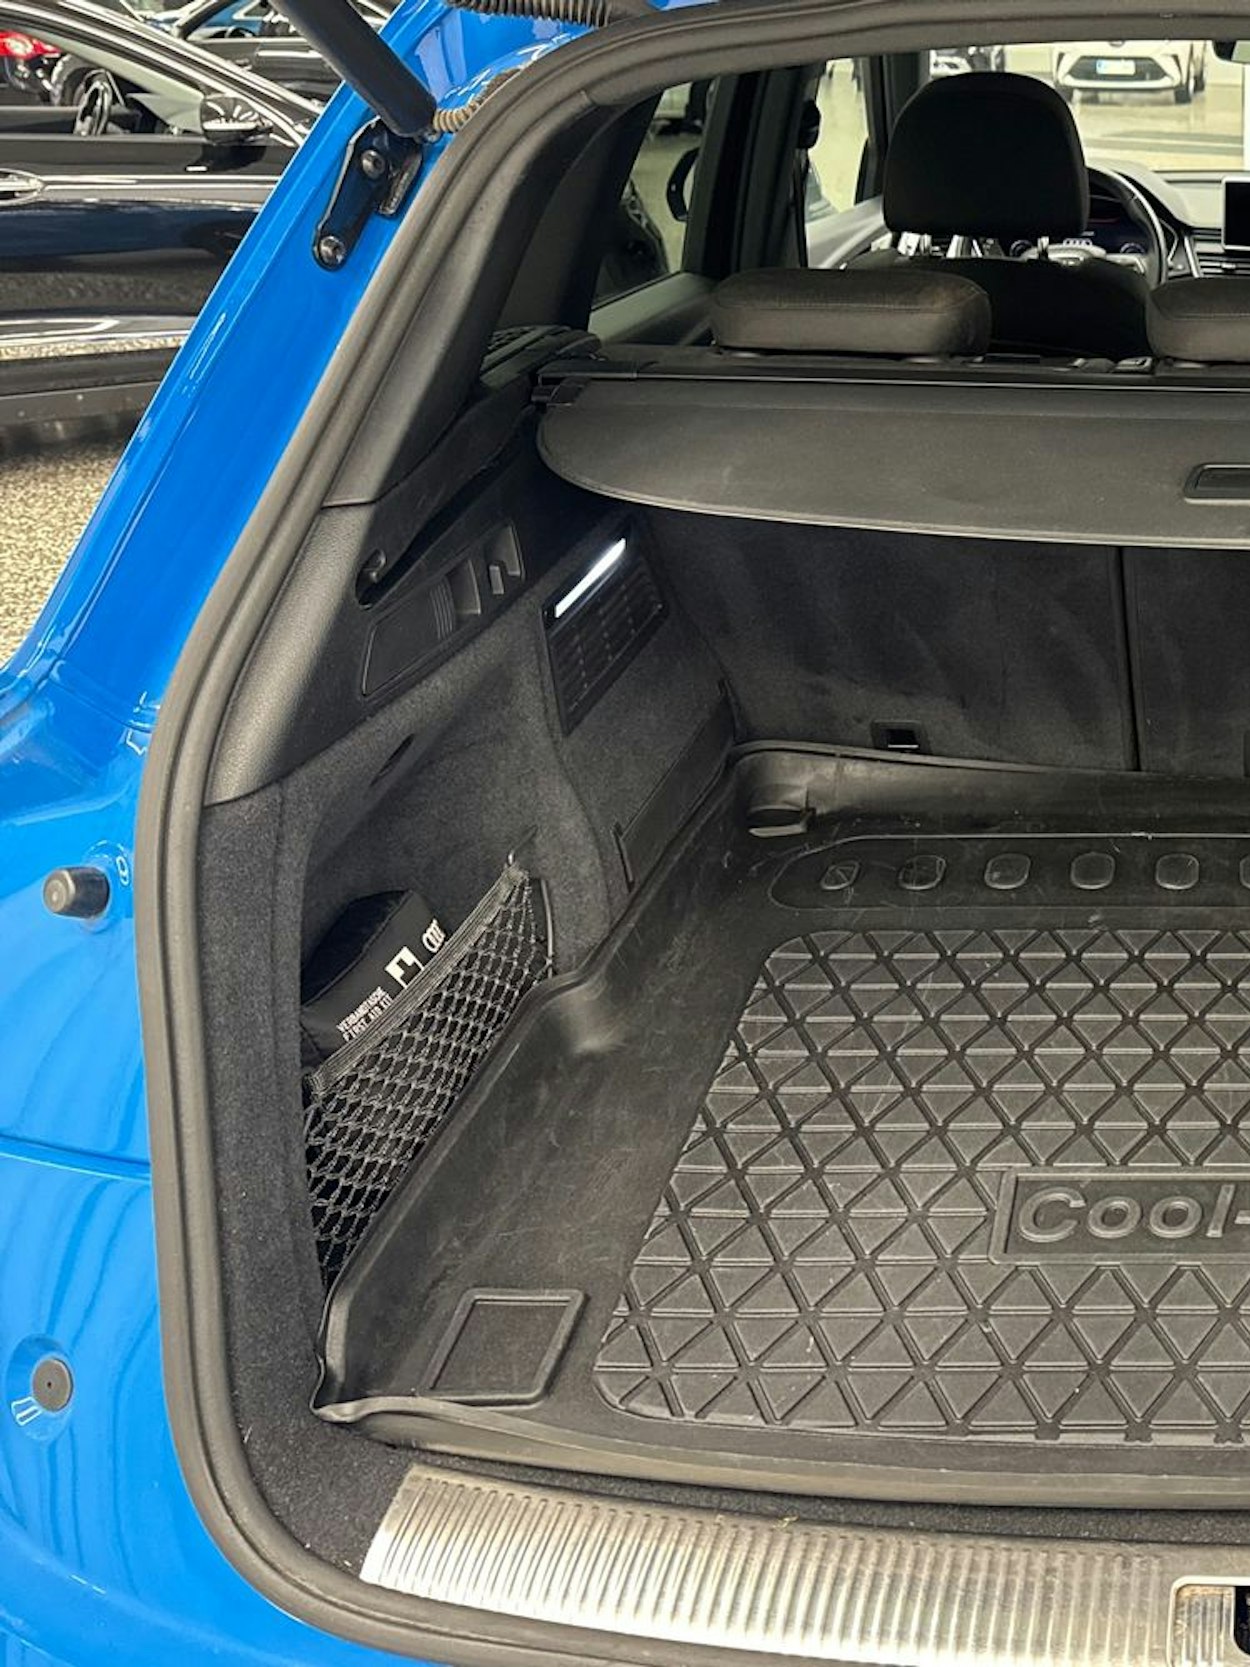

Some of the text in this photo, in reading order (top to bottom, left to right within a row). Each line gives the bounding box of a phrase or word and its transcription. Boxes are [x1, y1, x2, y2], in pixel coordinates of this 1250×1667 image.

[342, 993, 393, 1042] FIRST AID KIT
